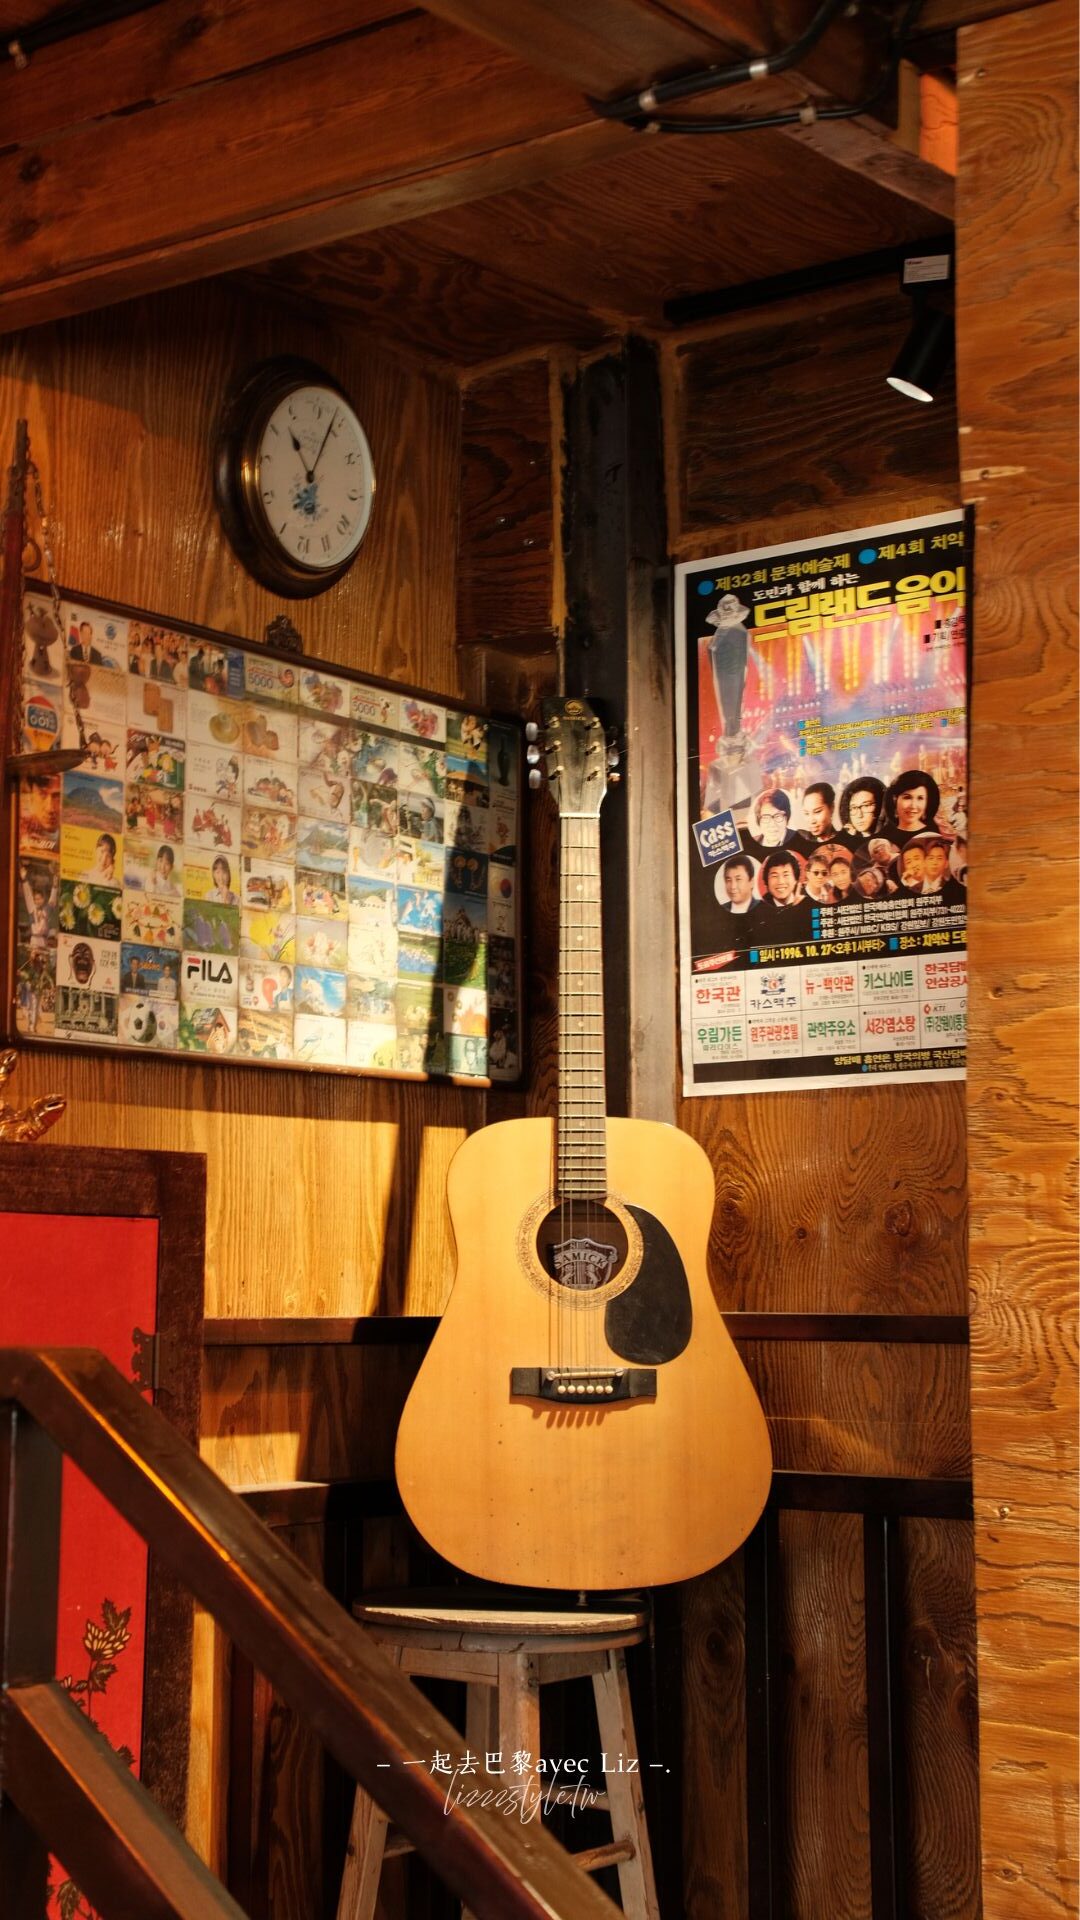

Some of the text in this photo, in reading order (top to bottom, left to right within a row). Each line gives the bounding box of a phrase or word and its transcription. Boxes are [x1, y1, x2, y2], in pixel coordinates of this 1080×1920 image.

[878, 538, 925, 561] 제4회
[715, 552, 850, 591] 제32회 문화예술제
[752, 571, 861, 602] 도민과 함께 하는
[753, 579, 893, 643] 드림랜드
[699, 820, 735, 848] Cass
[186, 956, 233, 985] FILA
[695, 985, 742, 1005] 한국관
[749, 995, 798, 1010] 카스맥주
[696, 1025, 742, 1044] 우림가든
[750, 1022, 799, 1043] 원주관광호텔
